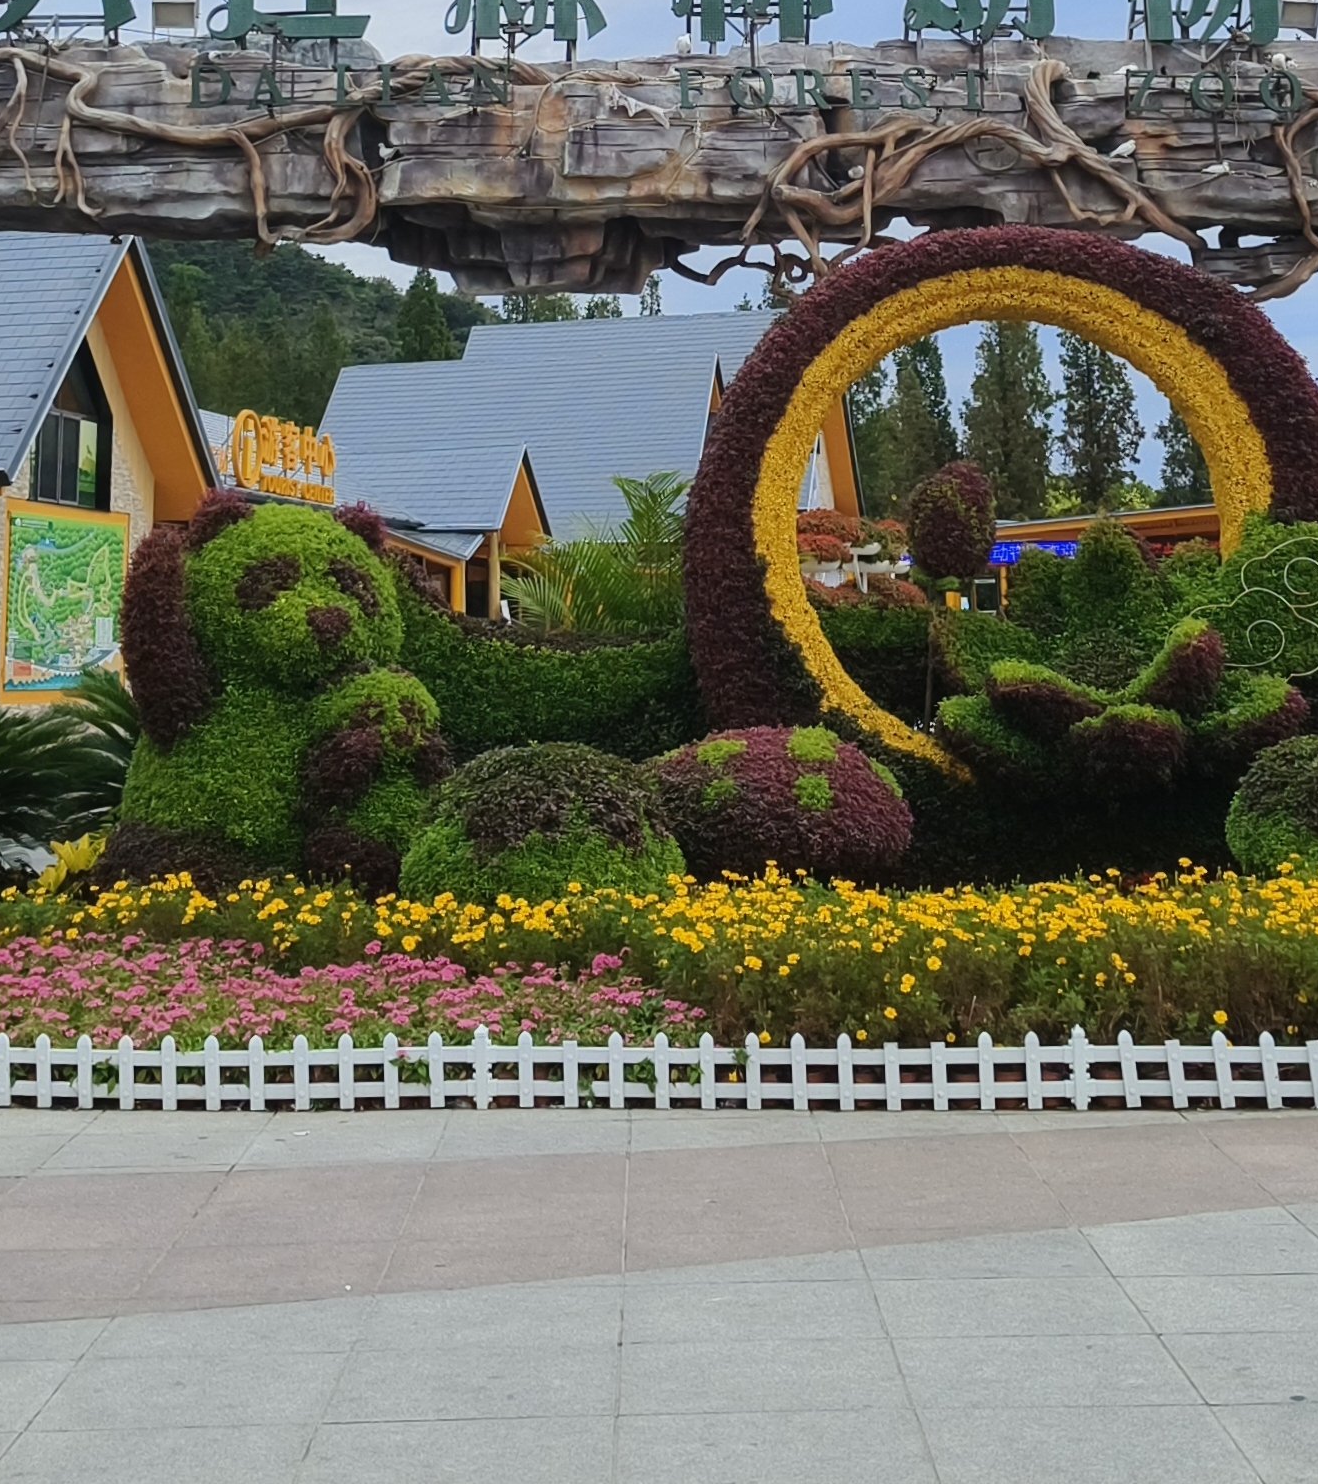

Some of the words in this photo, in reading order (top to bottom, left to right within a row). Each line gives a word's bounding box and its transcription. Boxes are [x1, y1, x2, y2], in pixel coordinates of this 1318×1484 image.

[675, 67, 989, 112] FOREST
[1127, 69, 1303, 115] ZOO
[261, 415, 336, 478] 游客中心
